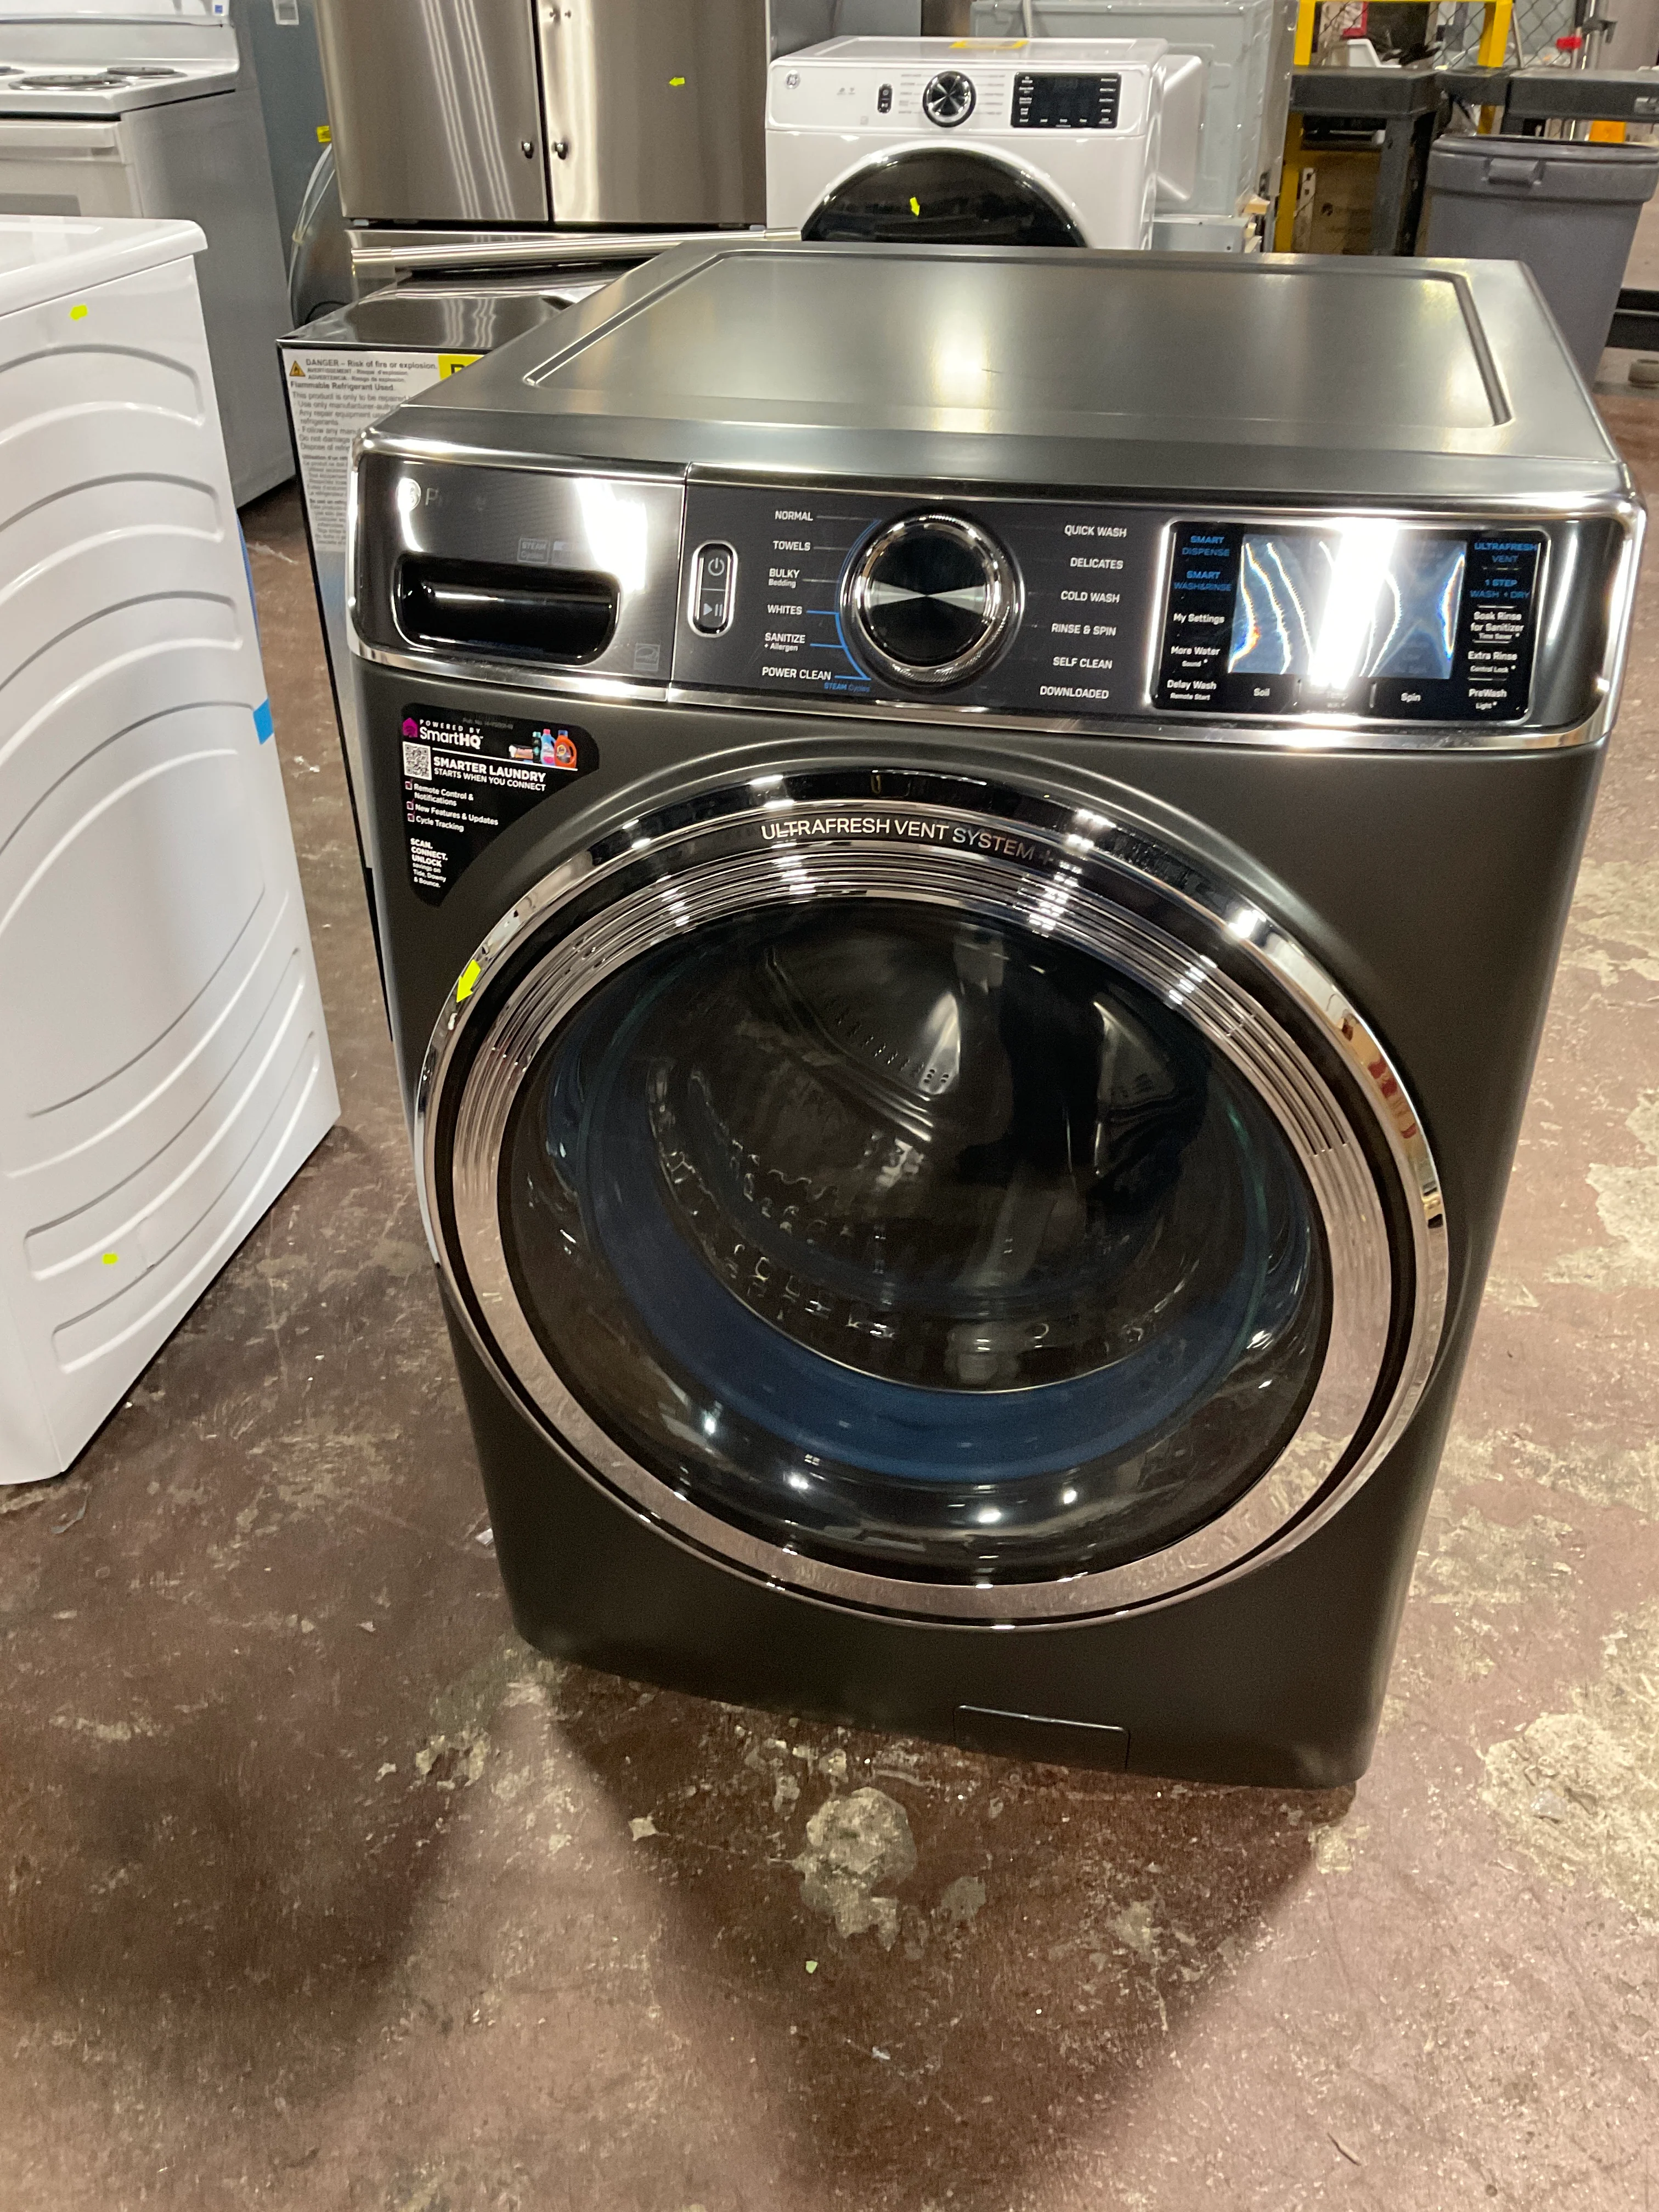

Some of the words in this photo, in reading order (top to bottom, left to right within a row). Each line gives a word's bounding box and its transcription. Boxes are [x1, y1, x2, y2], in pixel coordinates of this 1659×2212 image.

[399, 362, 437, 370] explosion.
[291, 381, 329, 389] Flammable
[332, 382, 372, 391] Refrigerant
[775, 511, 813, 522] NORMAL
[1064, 524, 1094, 537] QUICK
[1097, 526, 1127, 538] WASH
[1190, 535, 1224, 544] SMART
[773, 540, 811, 551] TOWELS
[1474, 543, 1538, 551] ULTRAFRESH
[1182, 548, 1229, 556] DISPENSE
[1070, 557, 1124, 569] DELICATES
[769, 568, 799, 579] BULKY
[1186, 571, 1220, 579] SMART
[768, 578, 796, 589] Bedding
[1061, 591, 1087, 601] COLD
[1090, 592, 1120, 603] WASH
[1470, 590, 1499, 599] WASH
[767, 605, 803, 615] WHITES
[1173, 613, 1187, 623] My
[1188, 614, 1225, 624] Settings
[1474, 612, 1495, 620] Soak
[1498, 612, 1522, 621] Rinse
[1051, 623, 1080, 634] RINSE
[1083, 625, 1091, 635] &
[1093, 626, 1116, 636] SPIN
[1470, 623, 1484, 632] for
[1486, 623, 1523, 633] Sanitizer
[765, 633, 806, 644] SANITIZE
[770, 642, 798, 652] Allergen
[1171, 646, 1192, 655] More
[1194, 647, 1220, 656] Water
[1468, 651, 1491, 661] Extra
[1493, 651, 1517, 661] Rinse
[1053, 656, 1077, 668] SELF
[1080, 658, 1113, 669] CLEAN
[762, 667, 796, 678] POWER
[799, 669, 831, 680] CLEAN
[824, 682, 847, 691] STEAM
[1167, 679, 1191, 690] Delay
[1193, 681, 1217, 690] Wash
[1040, 686, 1109, 699] DOWNLOADED
[1254, 688, 1270, 697] Soil
[1401, 693, 1421, 702] Spin
[1469, 689, 1507, 698] PreWash
[419, 719, 464, 732] POWERED
[433, 756, 487, 775] SMARTER
[489, 765, 546, 783] LAUNDRY
[434, 767, 462, 780] STARTS
[463, 771, 487, 783] WHEN
[488, 776, 505, 786] YOU
[507, 778, 546, 792] CONNECT
[414, 783, 441, 795] Remote
[441, 788, 467, 800] Control
[414, 791, 457, 806] Notifications
[415, 803, 430, 814] New
[431, 806, 460, 819] Features
[469, 814, 499, 826] Updates
[416, 815, 433, 827] Cycle
[436, 818, 464, 832] Tracking
[410, 838, 433, 849] SCAN.
[761, 817, 890, 841] ULTRAFRESH
[894, 820, 950, 840] VENT
[952, 827, 1035, 862] SYSTEM
[411, 847, 448, 861] CONNECT.
[411, 854, 442, 867] UNLOCK
